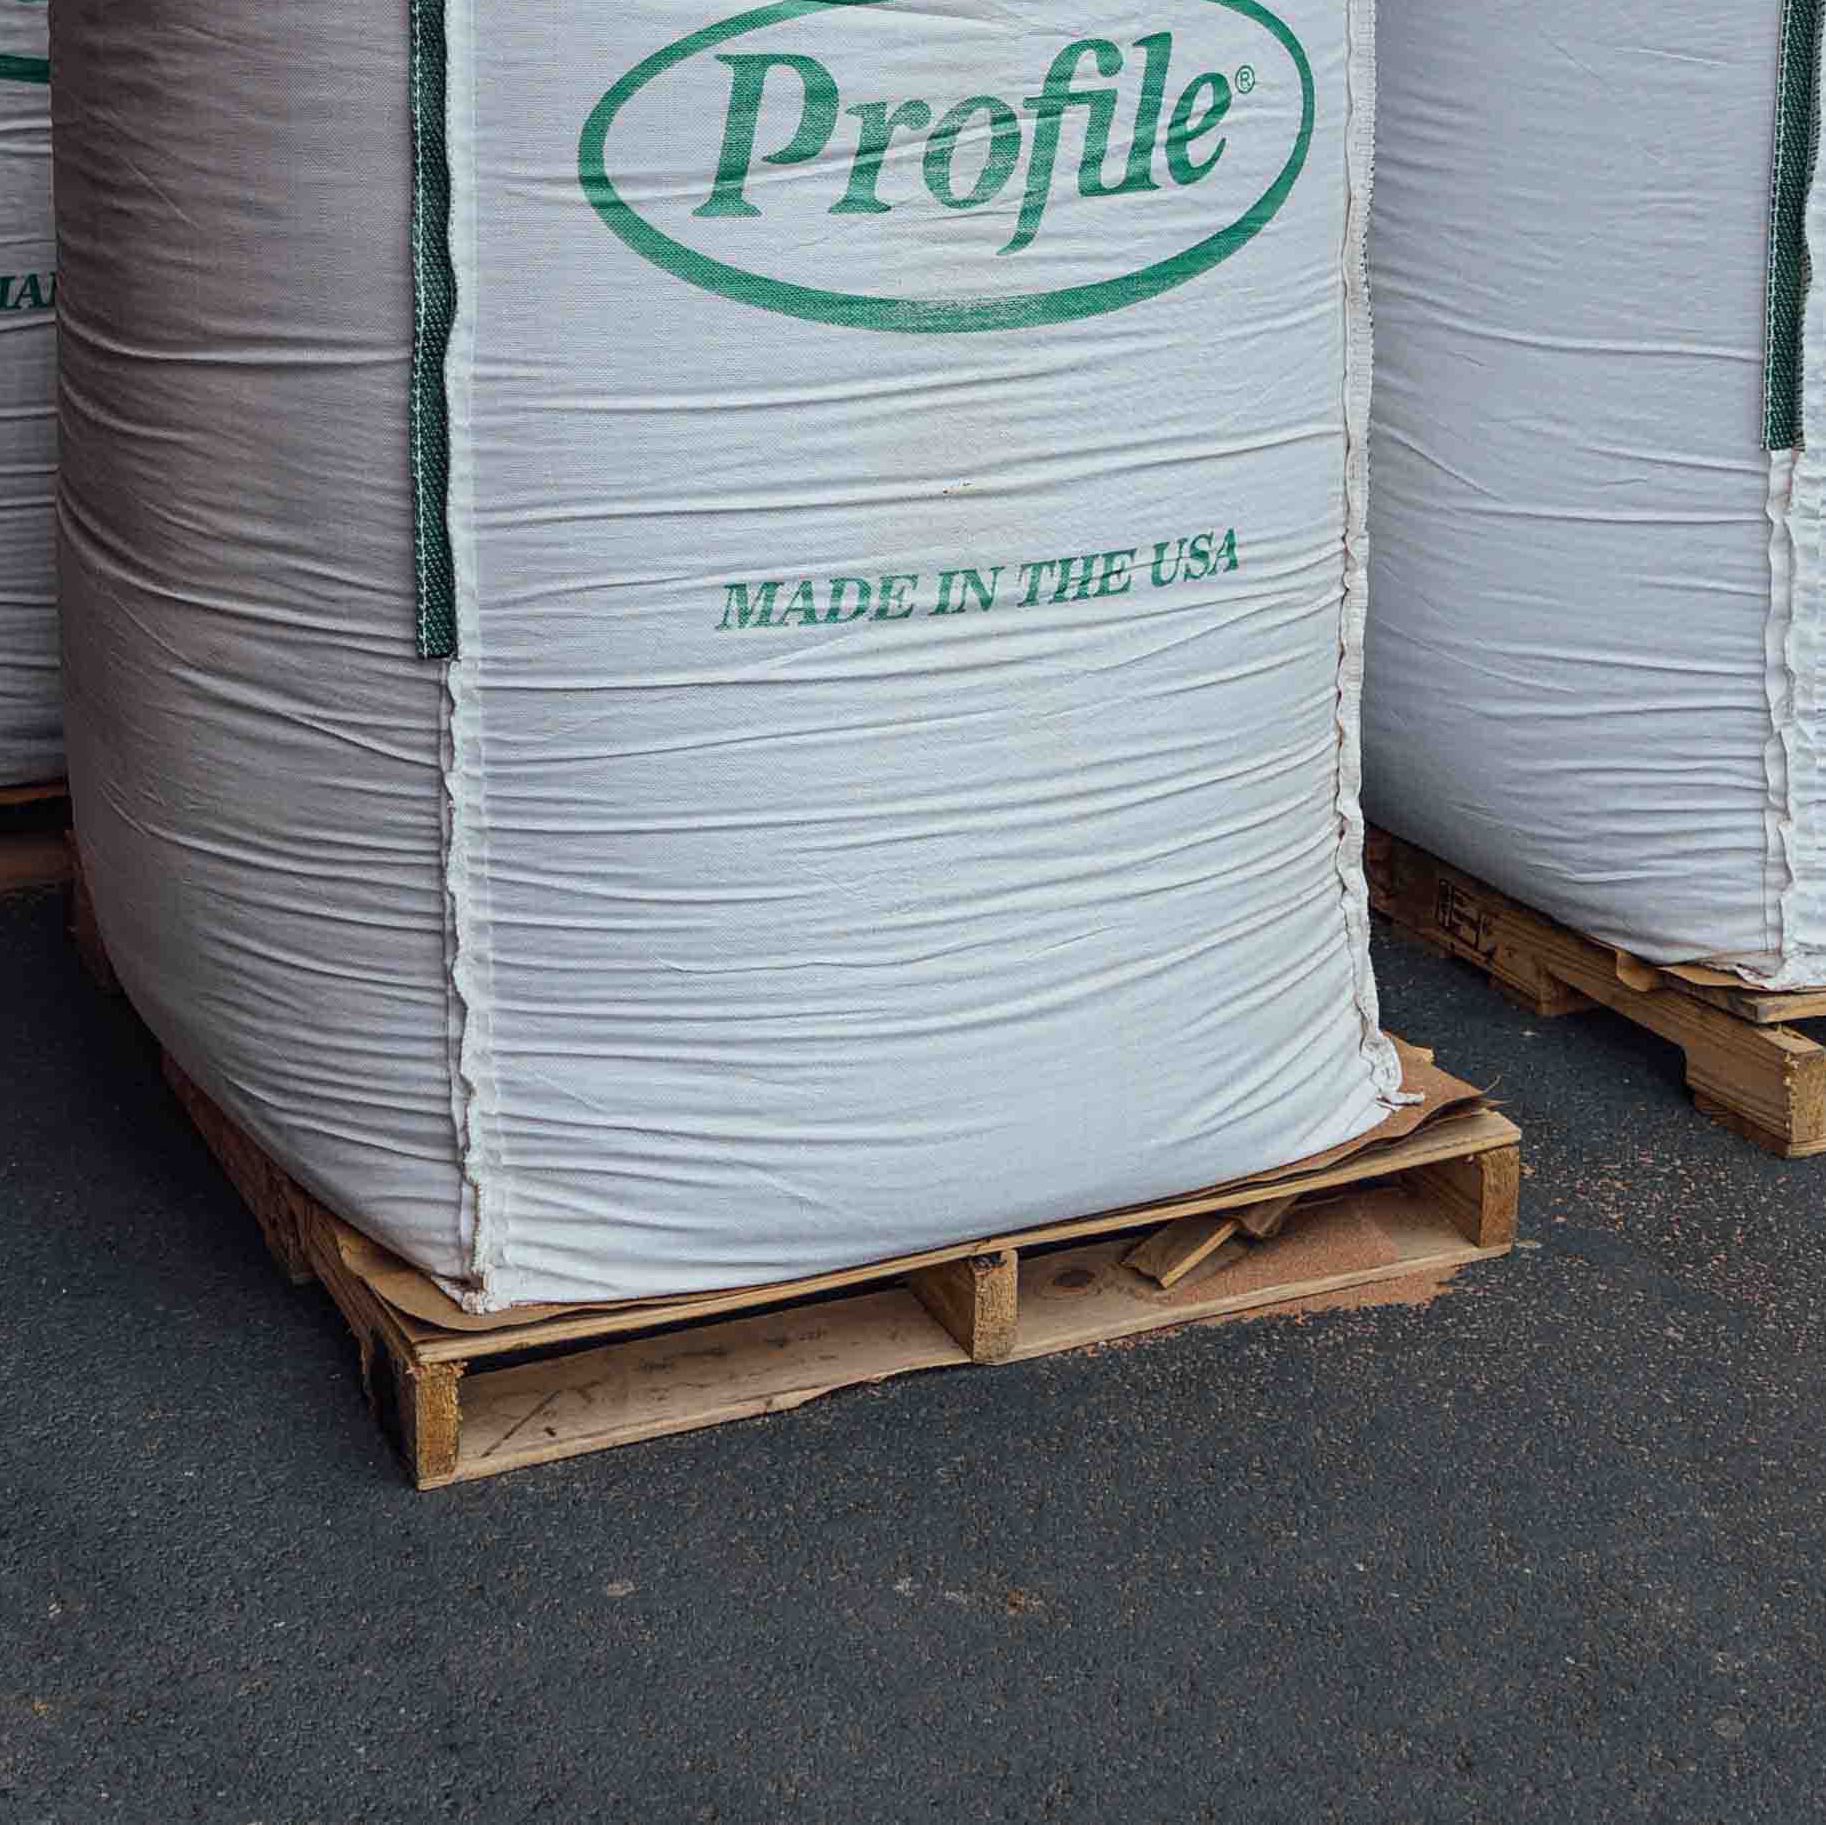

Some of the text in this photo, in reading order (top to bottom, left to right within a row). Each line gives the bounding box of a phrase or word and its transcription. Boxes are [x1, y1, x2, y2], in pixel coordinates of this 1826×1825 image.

[715, 527, 1240, 631] MADE IN THE USA
